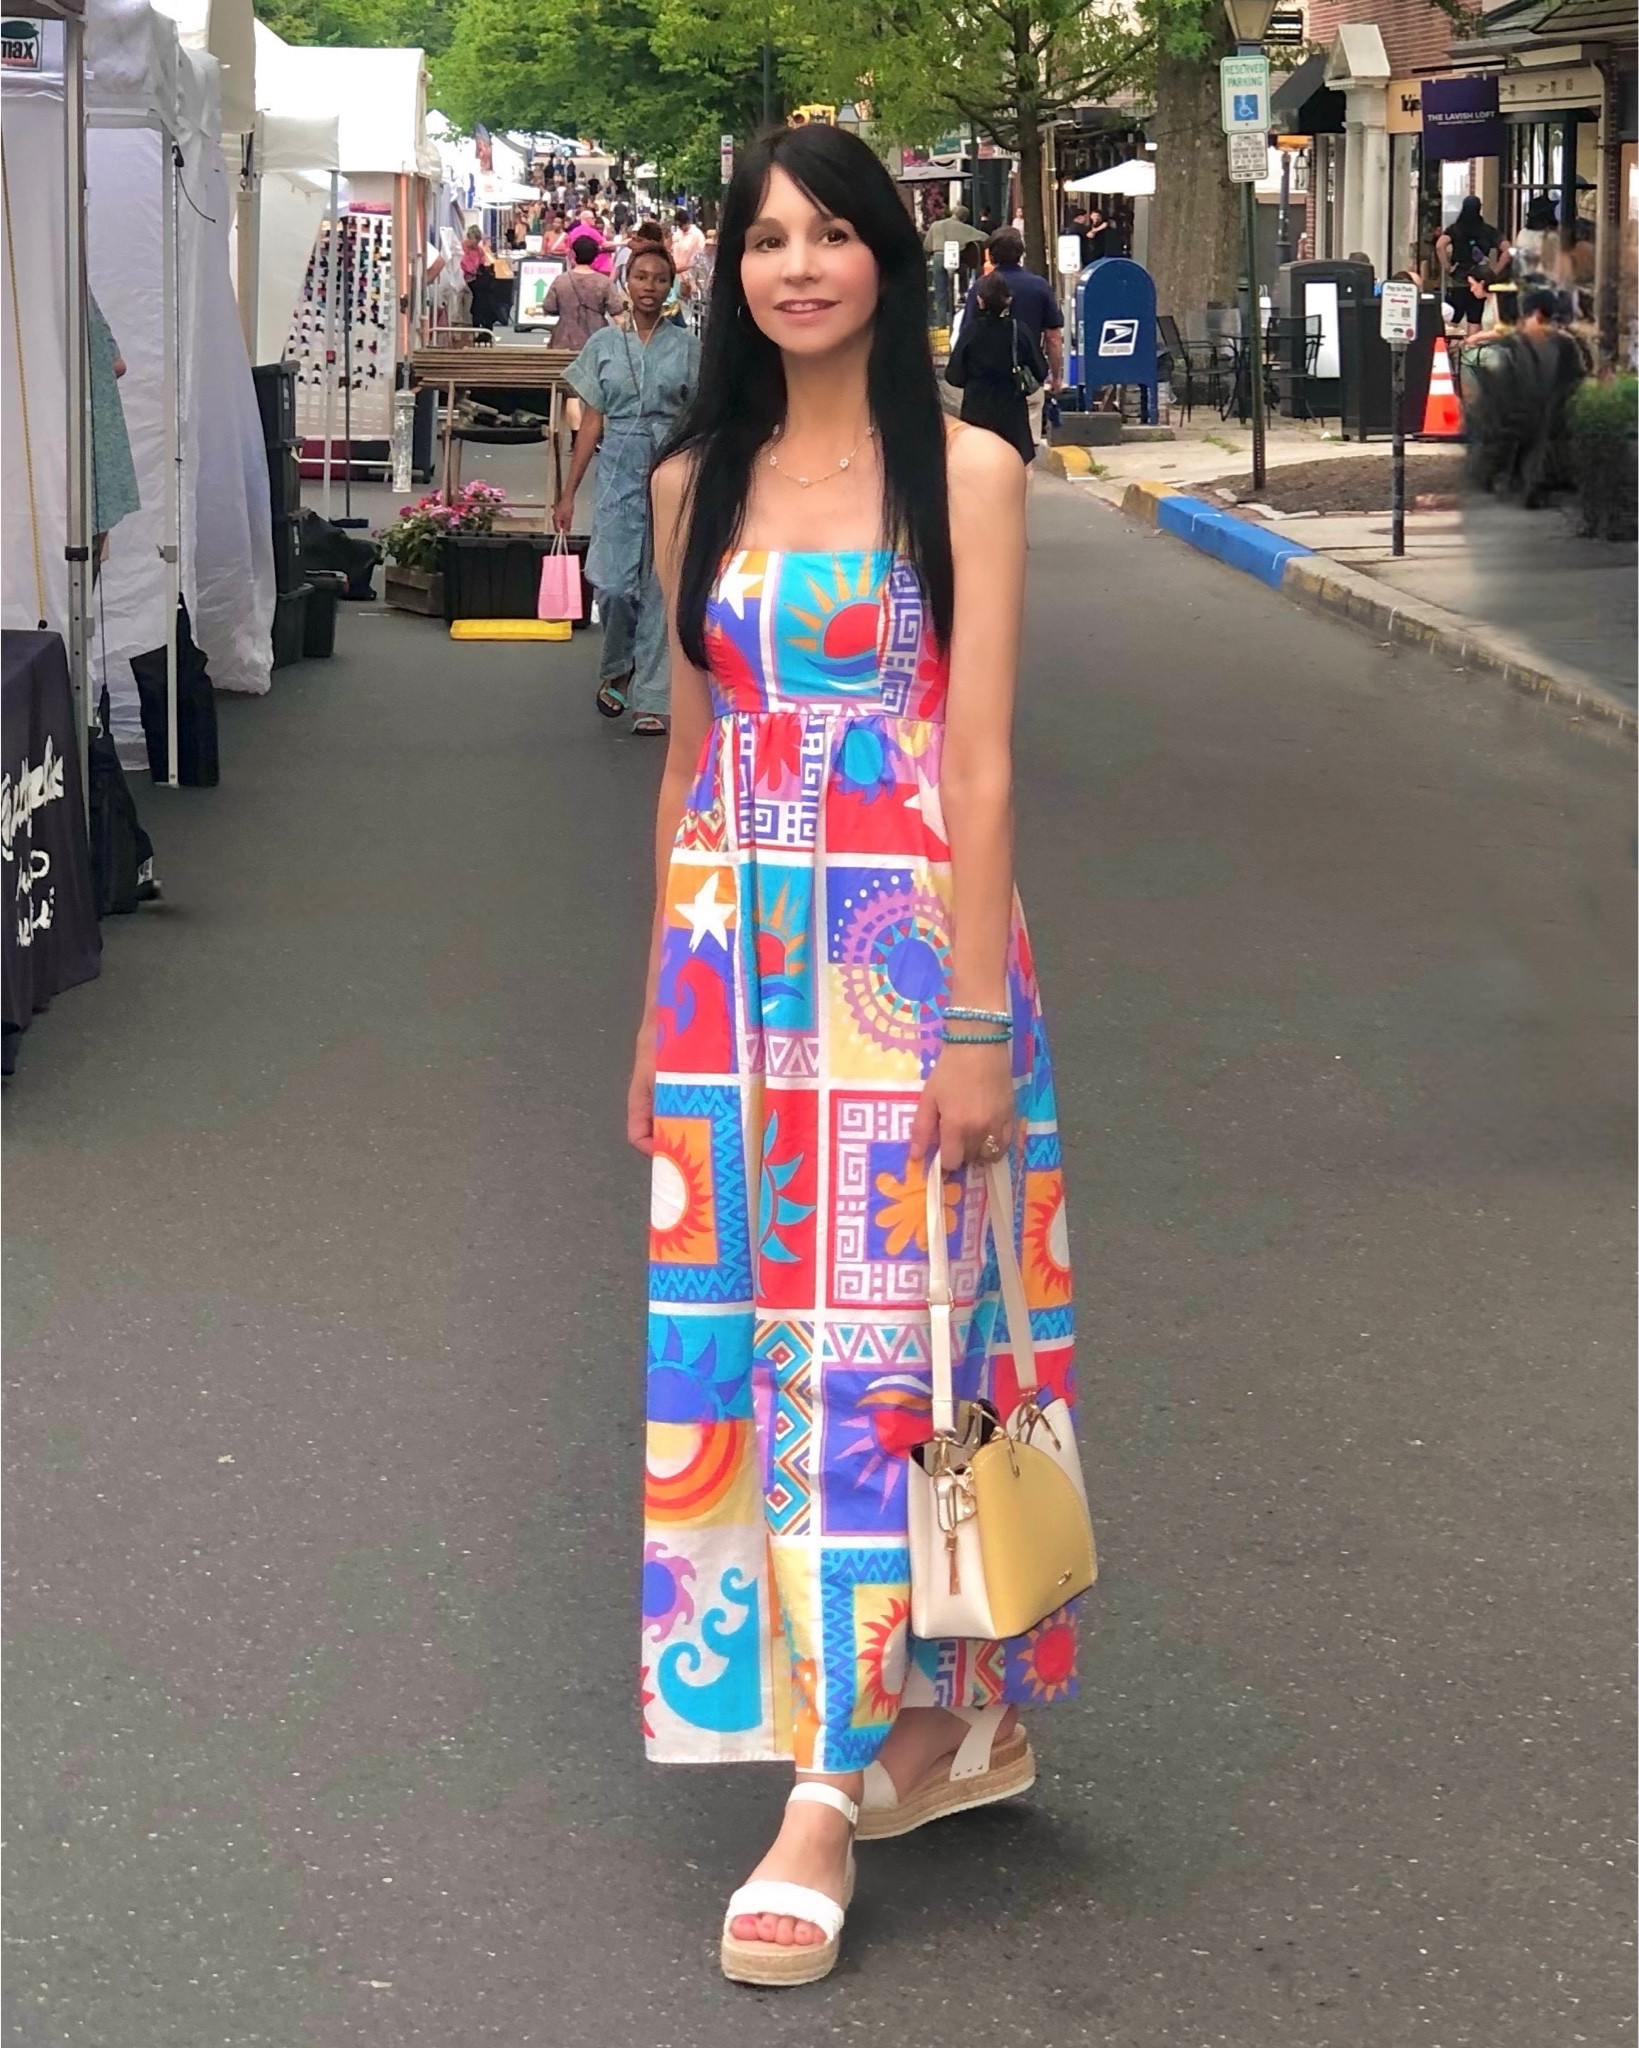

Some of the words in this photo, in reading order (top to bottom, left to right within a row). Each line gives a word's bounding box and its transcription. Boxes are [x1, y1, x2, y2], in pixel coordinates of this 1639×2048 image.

[1224, 64, 1266, 74] RESERVED
[1227, 76, 1263, 87] PARKING
[1427, 113, 1443, 122] THE
[1445, 112, 1473, 121] LAVISH
[1475, 111, 1495, 119] LOFT
